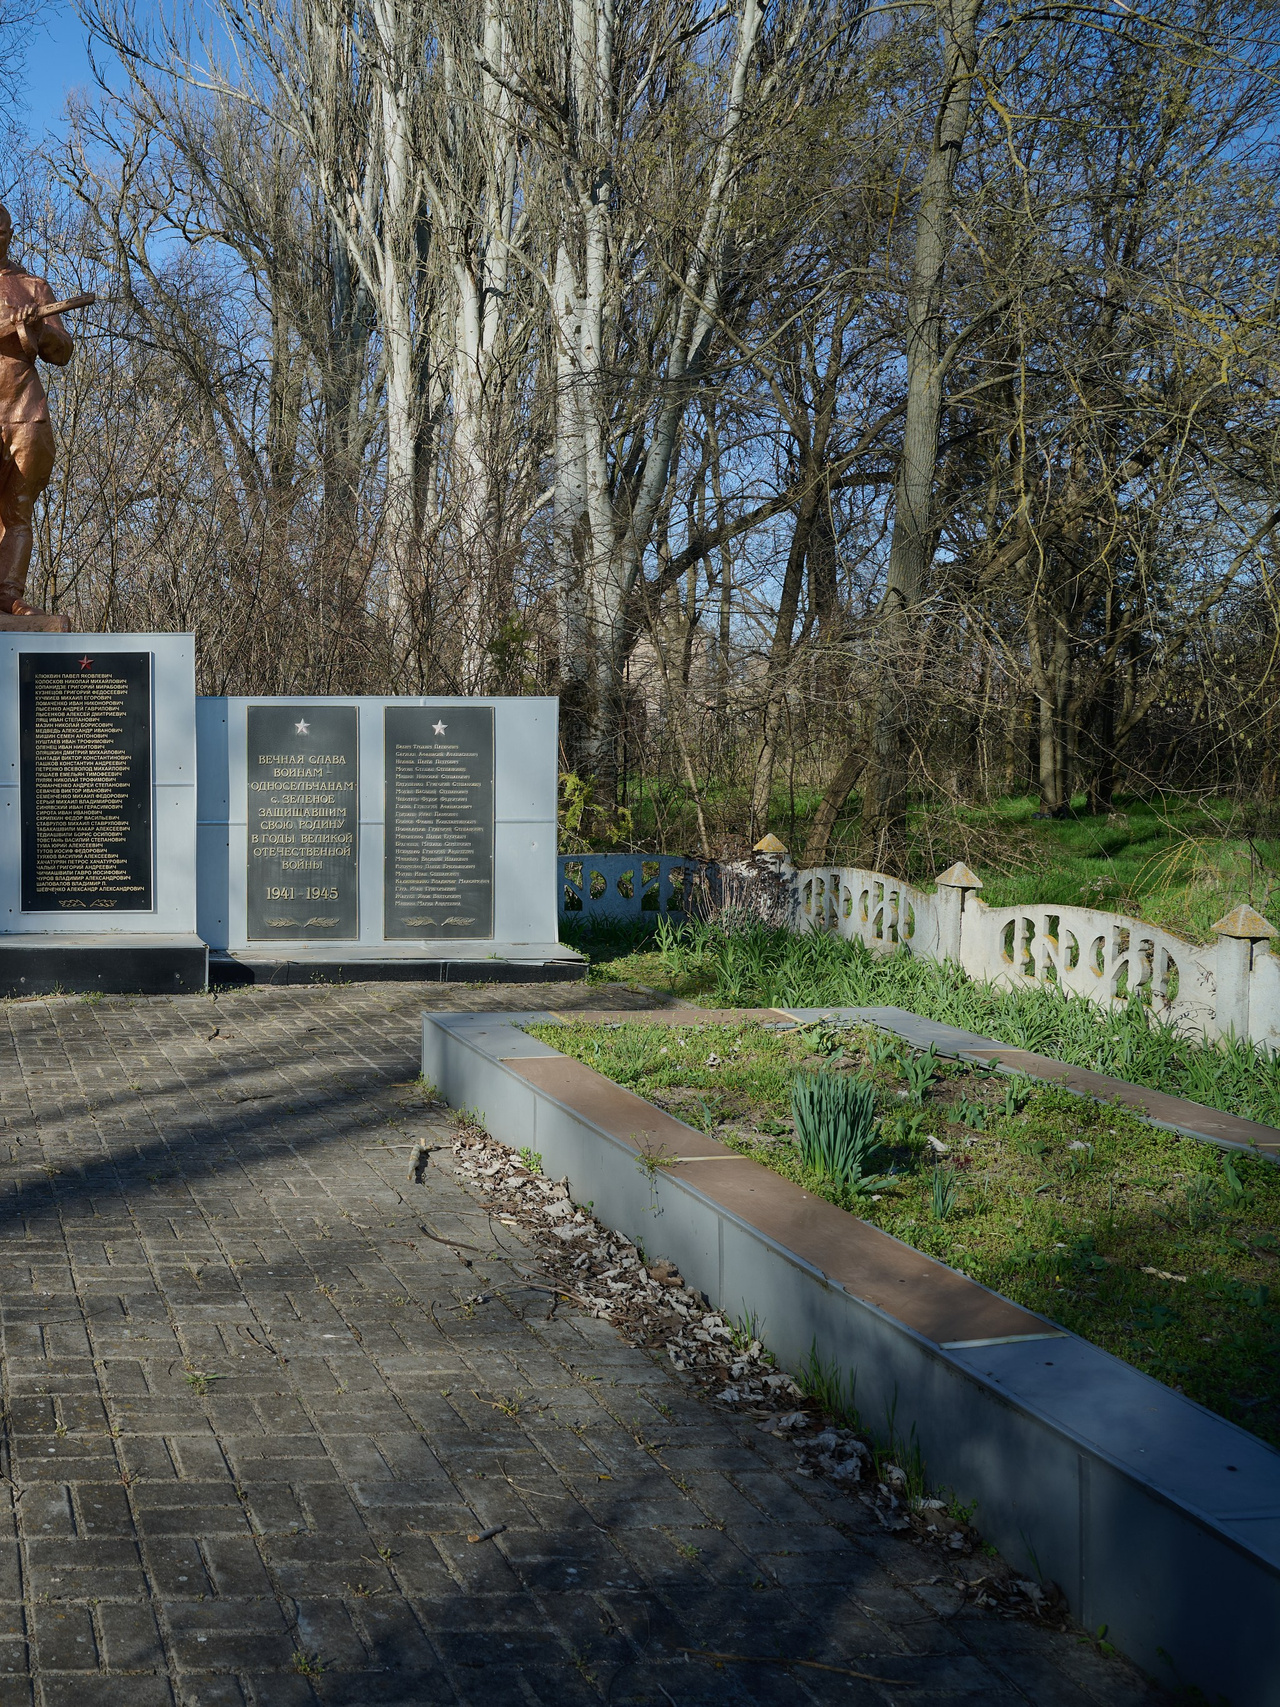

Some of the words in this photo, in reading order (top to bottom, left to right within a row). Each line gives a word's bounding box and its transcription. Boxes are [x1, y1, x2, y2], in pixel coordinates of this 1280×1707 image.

[258, 755, 304, 764] ВЕЧНАЯ
[309, 755, 346, 764] СЛАВА
[274, 768, 323, 777] ВОИНАМ
[251, 782, 354, 792] ОДНОСЕЛЬЧАНАМ
[282, 795, 335, 804] ЗЕЛЕНОЕ
[258, 808, 347, 817] ЗАЩИЩАВШИМ
[260, 820, 293, 830] СВОЮ
[299, 820, 345, 830] РОДИНУ
[252, 835, 259, 843] В
[262, 835, 295, 844] ГОДЫ
[301, 833, 353, 843] ВЕЛИКОЙ
[254, 846, 351, 857] ОТЕЧЕСТВЕННОЙ
[282, 859, 323, 870] ВОЙНЫ
